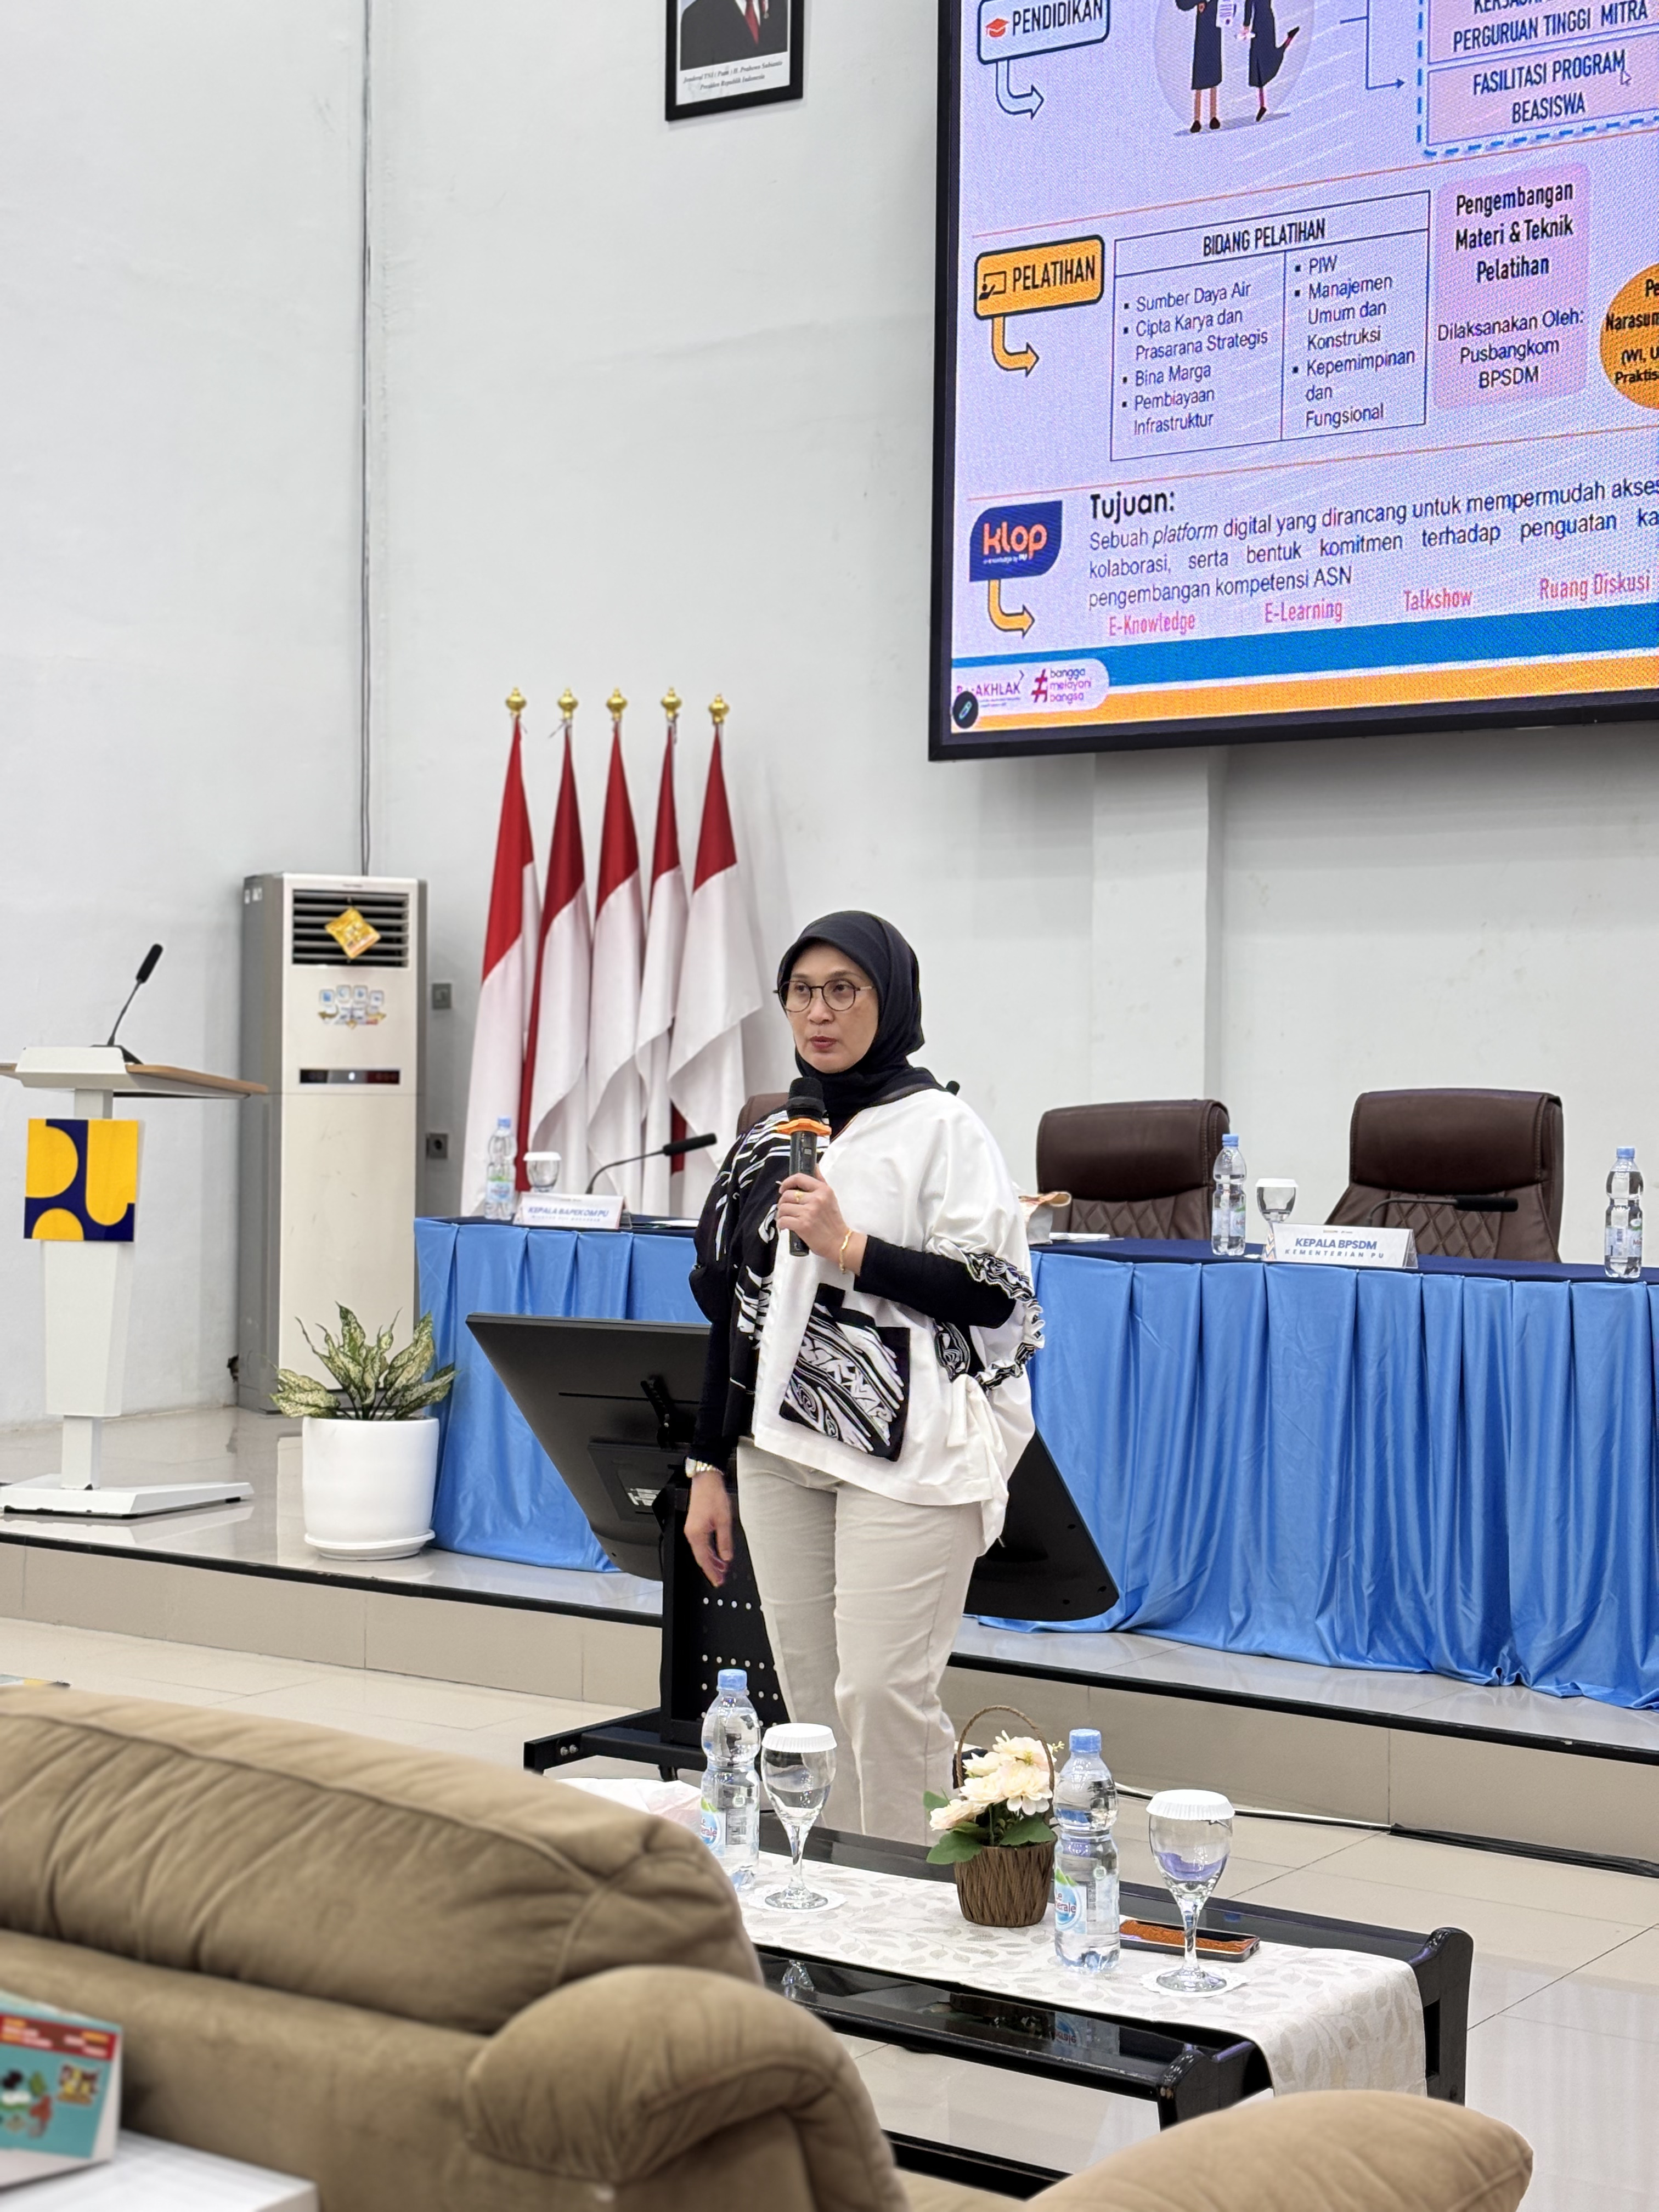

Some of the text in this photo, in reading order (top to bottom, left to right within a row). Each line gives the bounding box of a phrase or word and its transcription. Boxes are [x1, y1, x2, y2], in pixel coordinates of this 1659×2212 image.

[1013, 0, 1103, 36] PENDIDIKAN
[1453, 16, 1538, 52] PERGURUAN
[1543, 7, 1591, 36] TINGGI
[1600, 0, 1648, 26] MITRA
[1473, 49, 1626, 95] FASILITASI PROGRAM
[1512, 91, 1585, 124] BEASISWA
[1456, 182, 1574, 217] Pengembangan
[1203, 218, 1325, 257] BIDANG PELATIHAN
[1455, 213, 1574, 251] Materi & Teknik
[1012, 255, 1095, 293] PELATIHAN
[1309, 255, 1338, 274] PIW
[1476, 255, 1549, 283] Pelatihan
[1136, 281, 1251, 313] Sumber Daya Air
[1308, 276, 1393, 301] Manajemen
[1136, 309, 1243, 338] Cipta Karya dan
[1308, 301, 1387, 324] Umum dan
[1438, 308, 1584, 341] Dilaksanakan Oleh:
[1136, 328, 1268, 360] Prasarana Strategis
[1307, 325, 1381, 351] Konstruksi
[1460, 338, 1559, 364] Pusbangkom
[1136, 363, 1211, 387] Bina Marga
[1306, 350, 1415, 377] Kepemimpinan
[1479, 365, 1539, 388] BPSDM
[1135, 388, 1215, 410] Pembiayaan
[1306, 385, 1333, 402] dan
[1134, 411, 1214, 435] Infrastruktur
[1306, 403, 1384, 429] Fungsional
[1090, 490, 1174, 523] Tujuan:
[1090, 529, 1148, 551] Sebuah
[1153, 523, 1217, 549] platform
[1223, 514, 1272, 540] digital
[1277, 514, 1316, 535] yang
[1322, 504, 1407, 527] dirancang
[1413, 495, 1460, 518] untuk
[1467, 481, 1605, 514] mempermudah
[983, 522, 1047, 560] klop
[1090, 554, 1171, 578] kolaborasi,
[1188, 550, 1228, 569] serta
[1247, 541, 1301, 564] bentuk
[1319, 534, 1403, 557] komitmen
[1422, 524, 1501, 548] terhadap
[1521, 514, 1616, 542] penguatan
[1089, 566, 1352, 611] pengembangan kompetensi ASN
[1539, 570, 1650, 601] Ruang Diskusi
[1265, 600, 1342, 624] E-Learning
[1404, 588, 1474, 612] Talkshow
[1109, 611, 1195, 636] E-Knowledge
[1050, 668, 1086, 680] bangga
[1050, 692, 1084, 704] bangsa
[528, 1206, 557, 1215] KEPALA
[1285, 1249, 1364, 1257] KEMENTERIAN
[1295, 1238, 1378, 1250] KEPALA BPSDM
